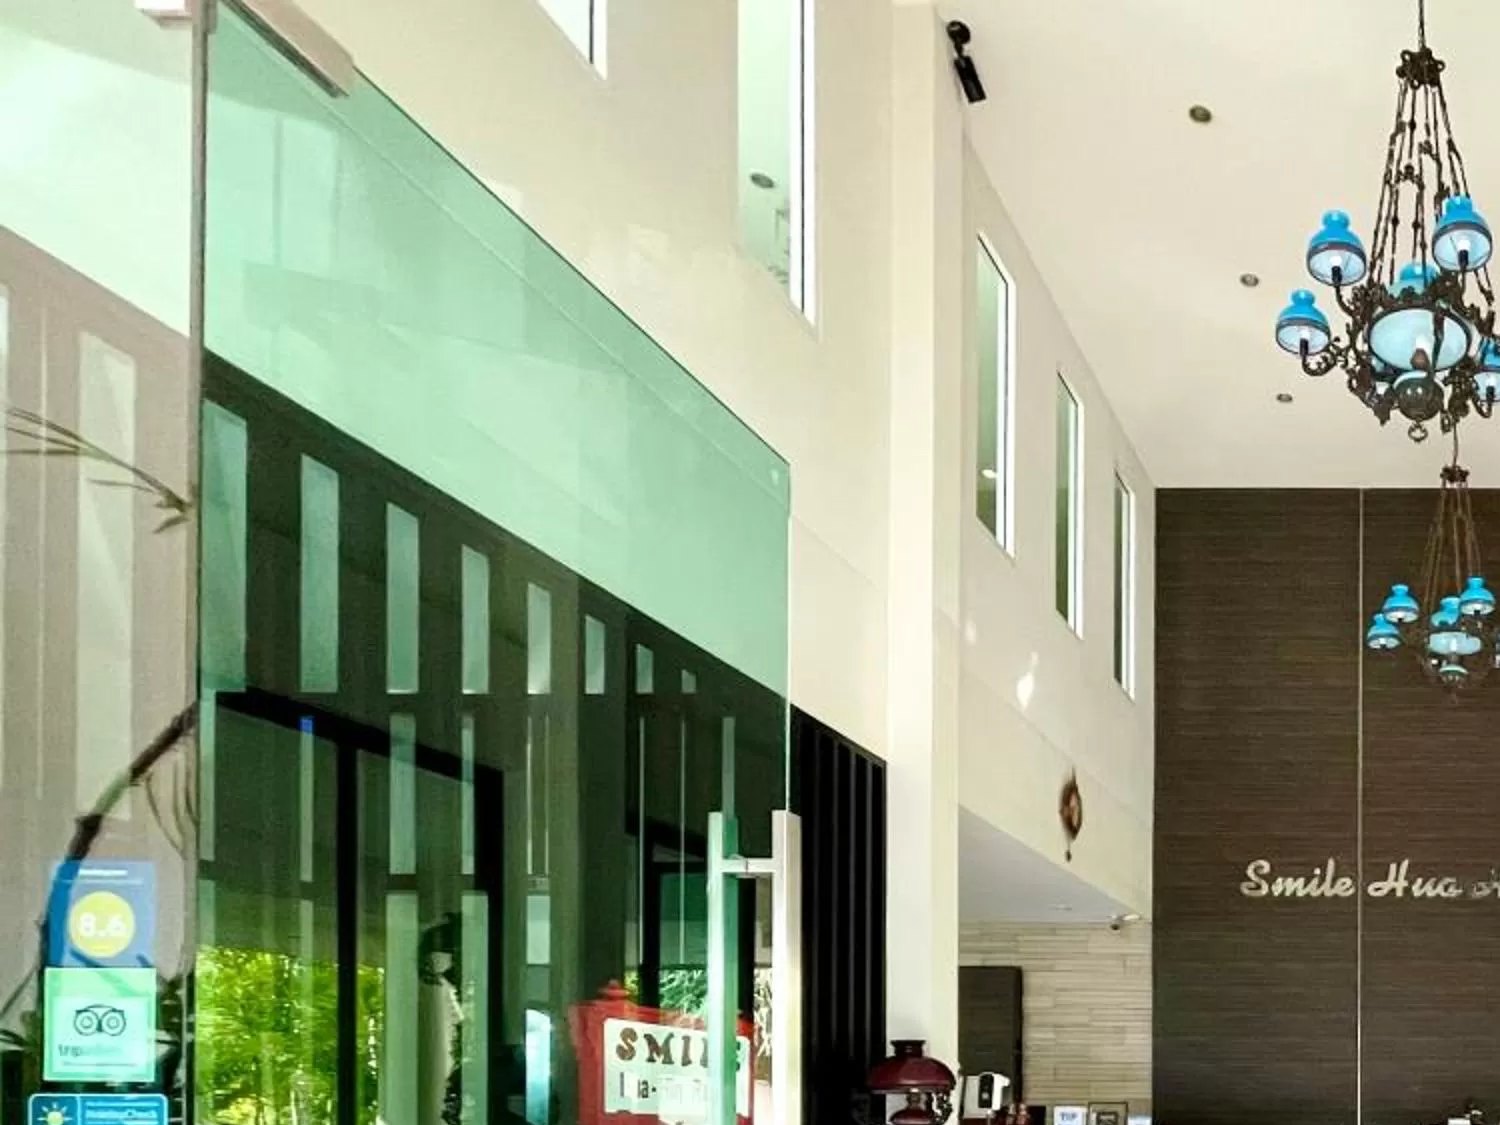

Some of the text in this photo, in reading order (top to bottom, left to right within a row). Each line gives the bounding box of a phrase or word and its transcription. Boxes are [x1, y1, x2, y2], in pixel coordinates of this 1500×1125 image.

[1240, 858, 1356, 898] Smile
[1367, 858, 1463, 899] Hua
[79, 912, 127, 938] 8.6
